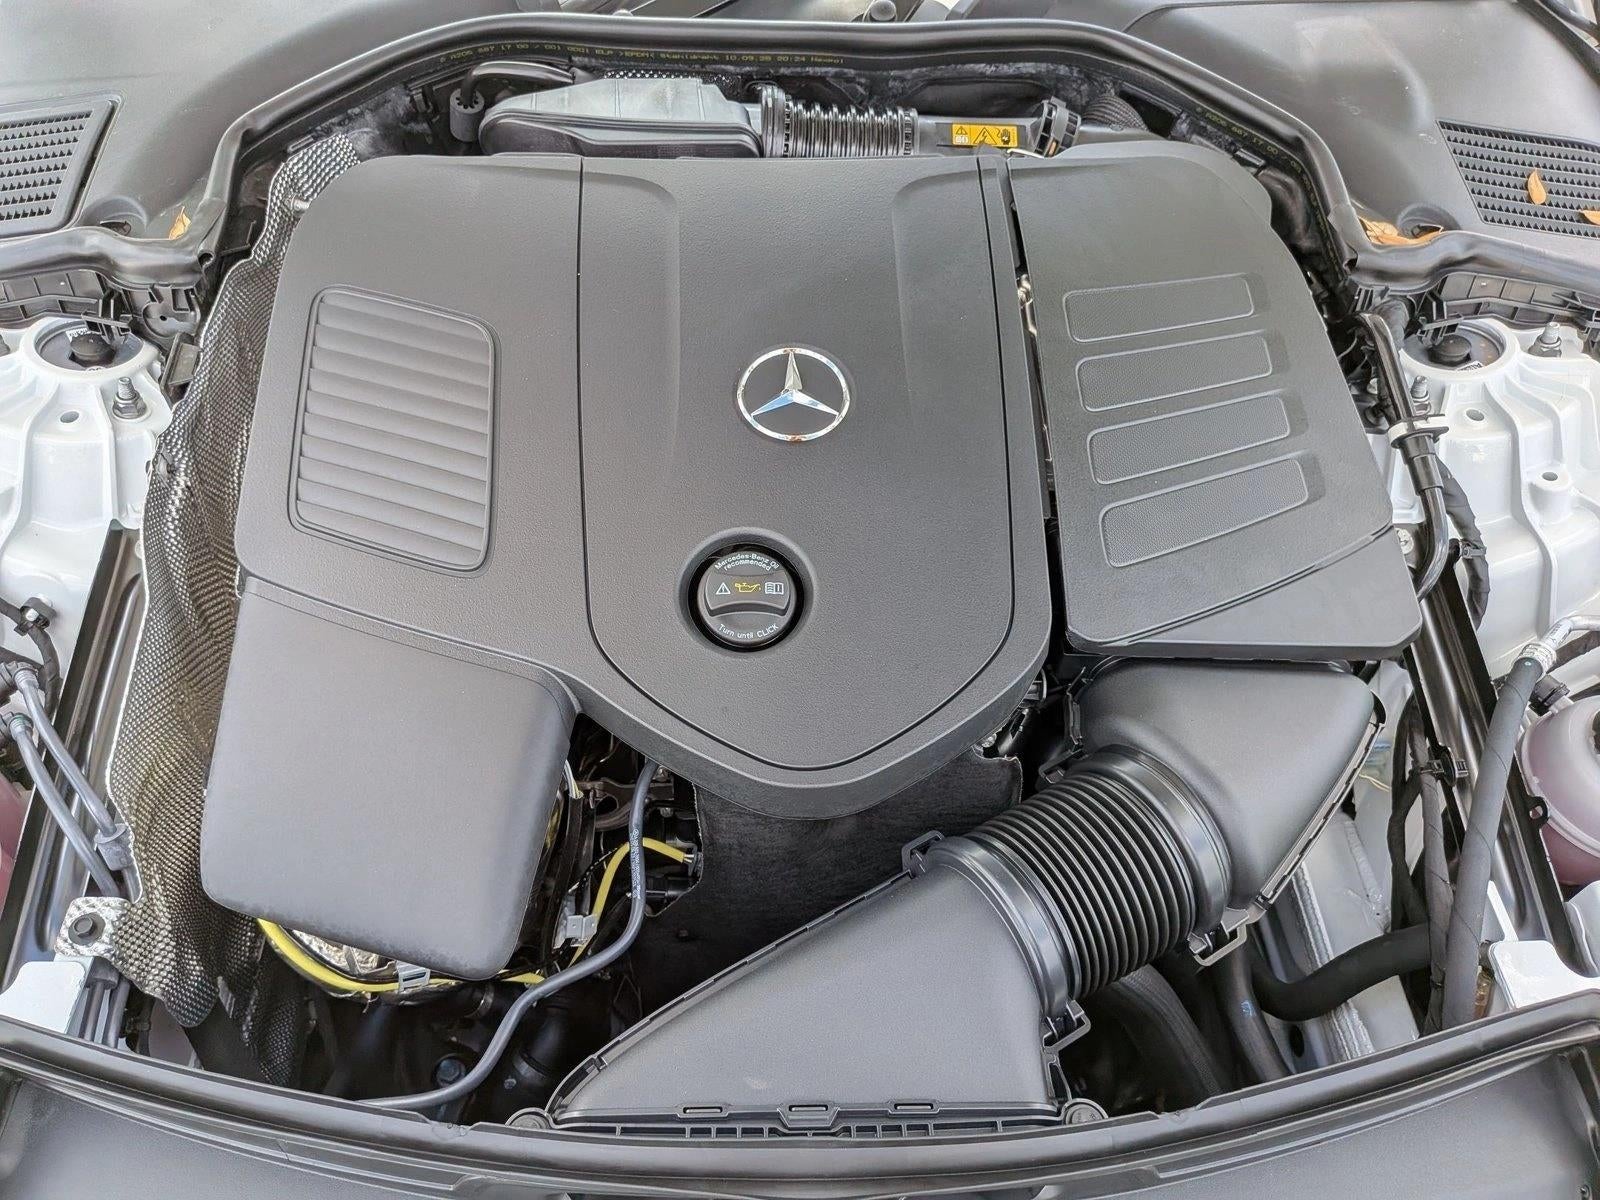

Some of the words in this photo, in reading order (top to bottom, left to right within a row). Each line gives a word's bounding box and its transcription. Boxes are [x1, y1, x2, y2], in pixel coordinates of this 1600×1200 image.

[714, 553, 769, 569] Mercedes-Benz
[770, 560, 780, 569] Oil
[723, 559, 771, 571] recommended
[718, 623, 735, 637] Turn
[756, 622, 779, 637] CLICK
